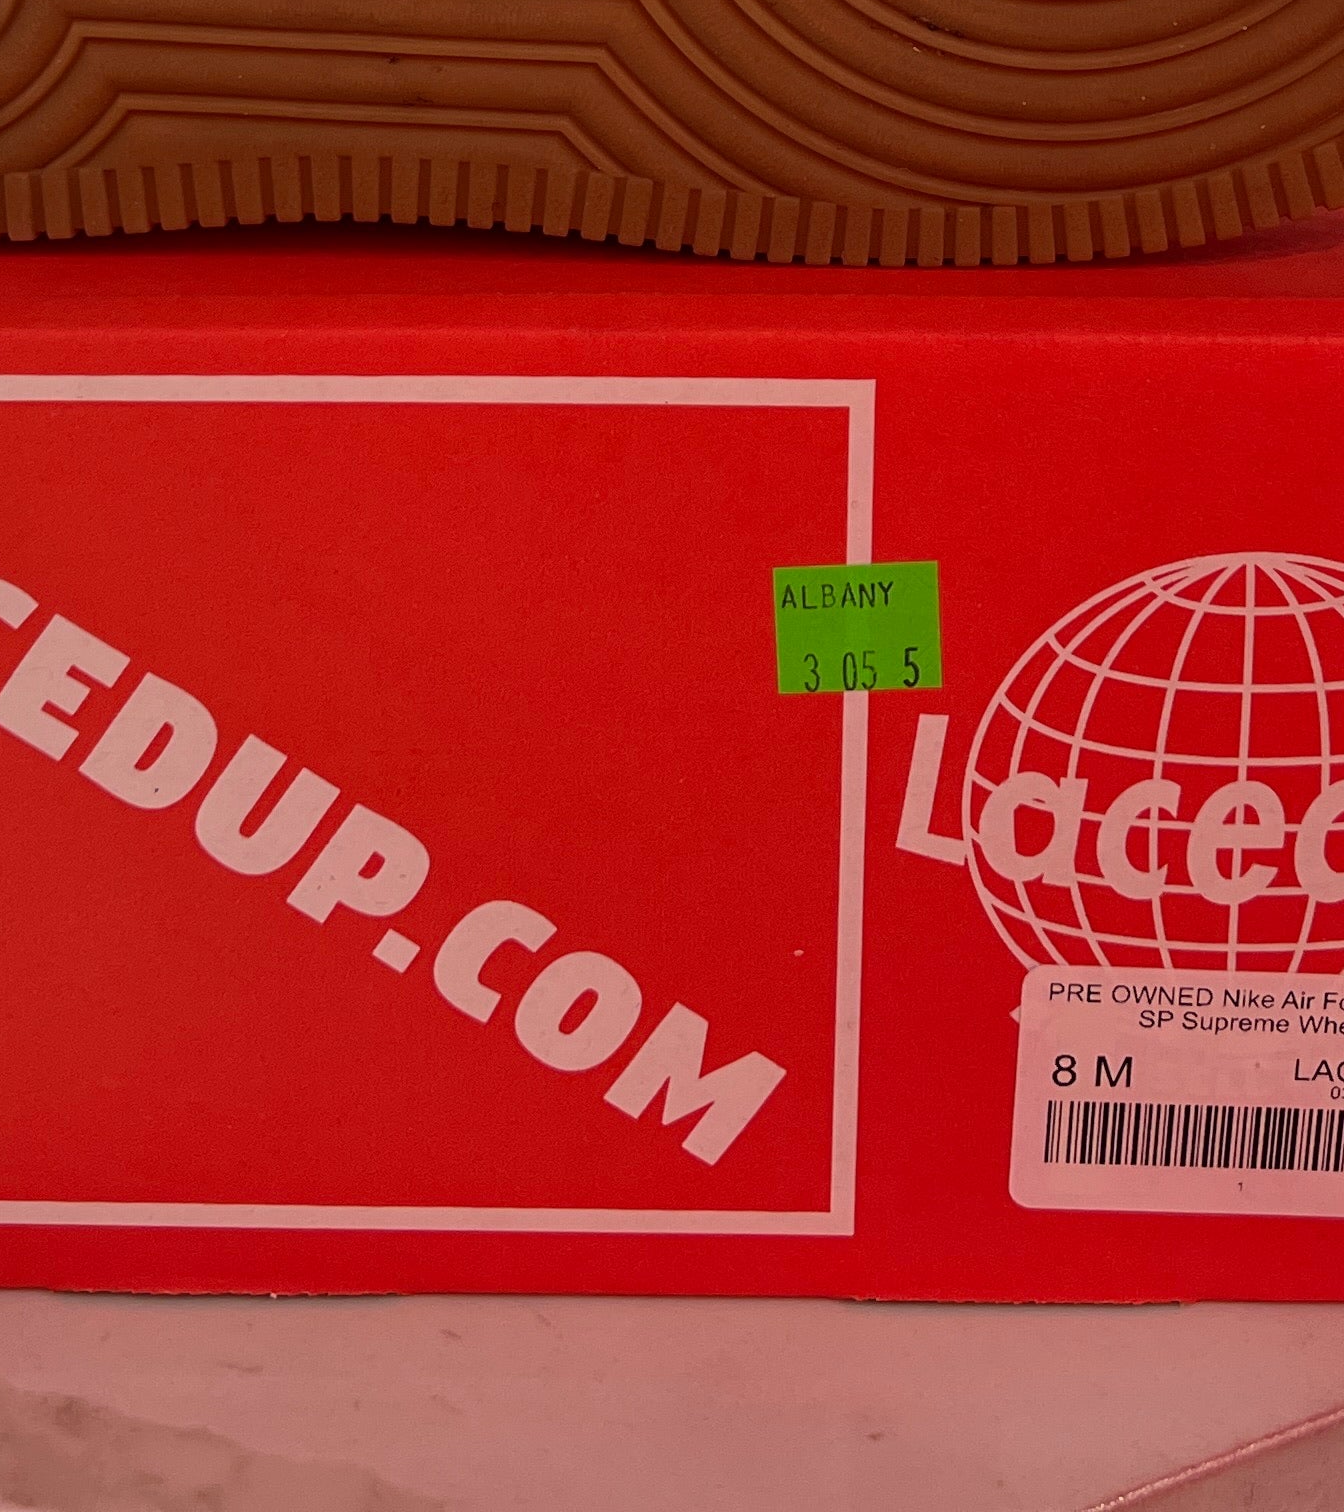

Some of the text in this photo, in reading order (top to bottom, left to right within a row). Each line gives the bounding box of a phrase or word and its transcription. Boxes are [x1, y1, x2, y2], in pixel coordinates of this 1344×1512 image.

[781, 581, 894, 610] ALBANY
[803, 653, 821, 693] 3
[1049, 982, 1103, 1004] PRE
[1111, 984, 1214, 1007] OWNED
[1223, 989, 1275, 1009] Nike
[1281, 990, 1316, 1010] Air
[1138, 1009, 1175, 1029] SP
[1182, 1011, 1290, 1036] Supreme
[1051, 1054, 1134, 1088] 8 M
